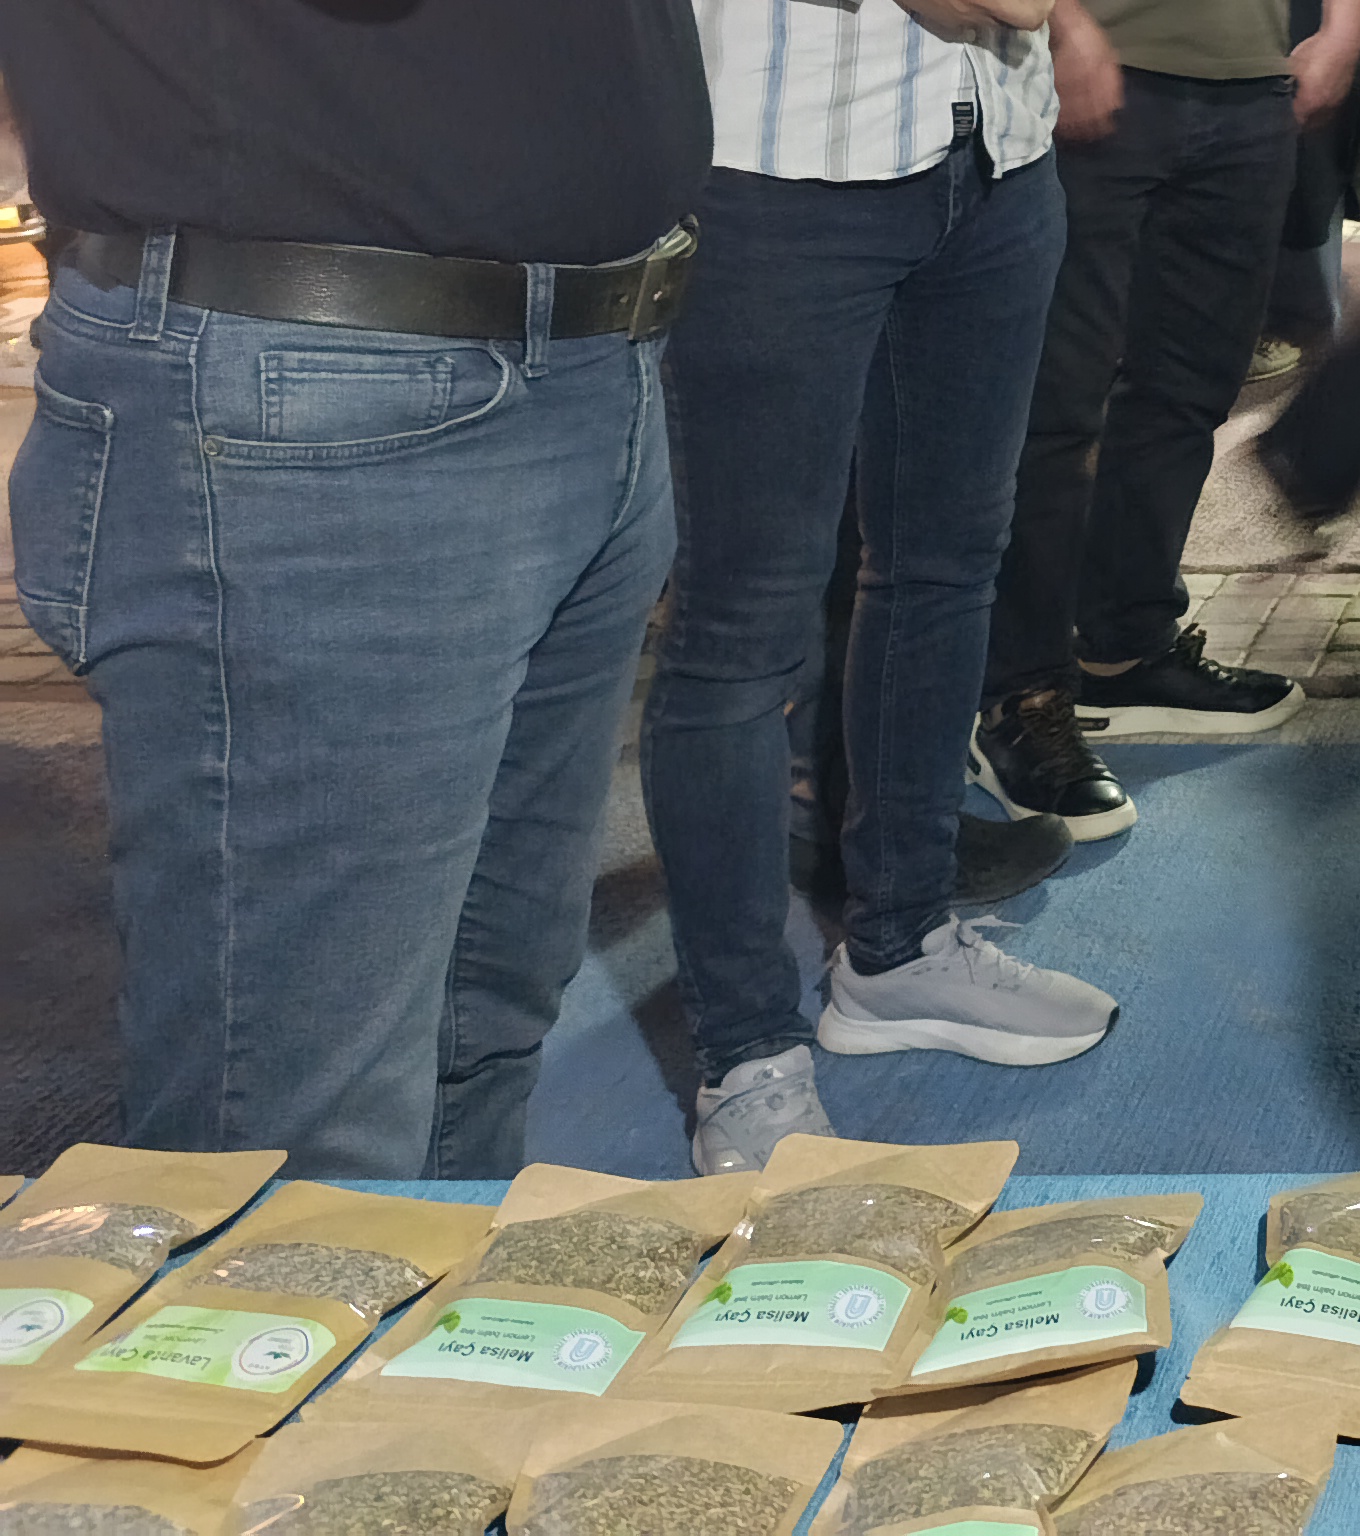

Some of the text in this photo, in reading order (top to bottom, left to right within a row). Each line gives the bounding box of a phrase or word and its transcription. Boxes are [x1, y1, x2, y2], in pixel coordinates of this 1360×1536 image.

[714, 1307, 810, 1323] Melisa Çayı
[1280, 1296, 1316, 1314] Çayı
[960, 1313, 1060, 1341] Melisa Çayı
[142, 1350, 212, 1371] Lavanta
[437, 1340, 535, 1363] Melisa Çayı
